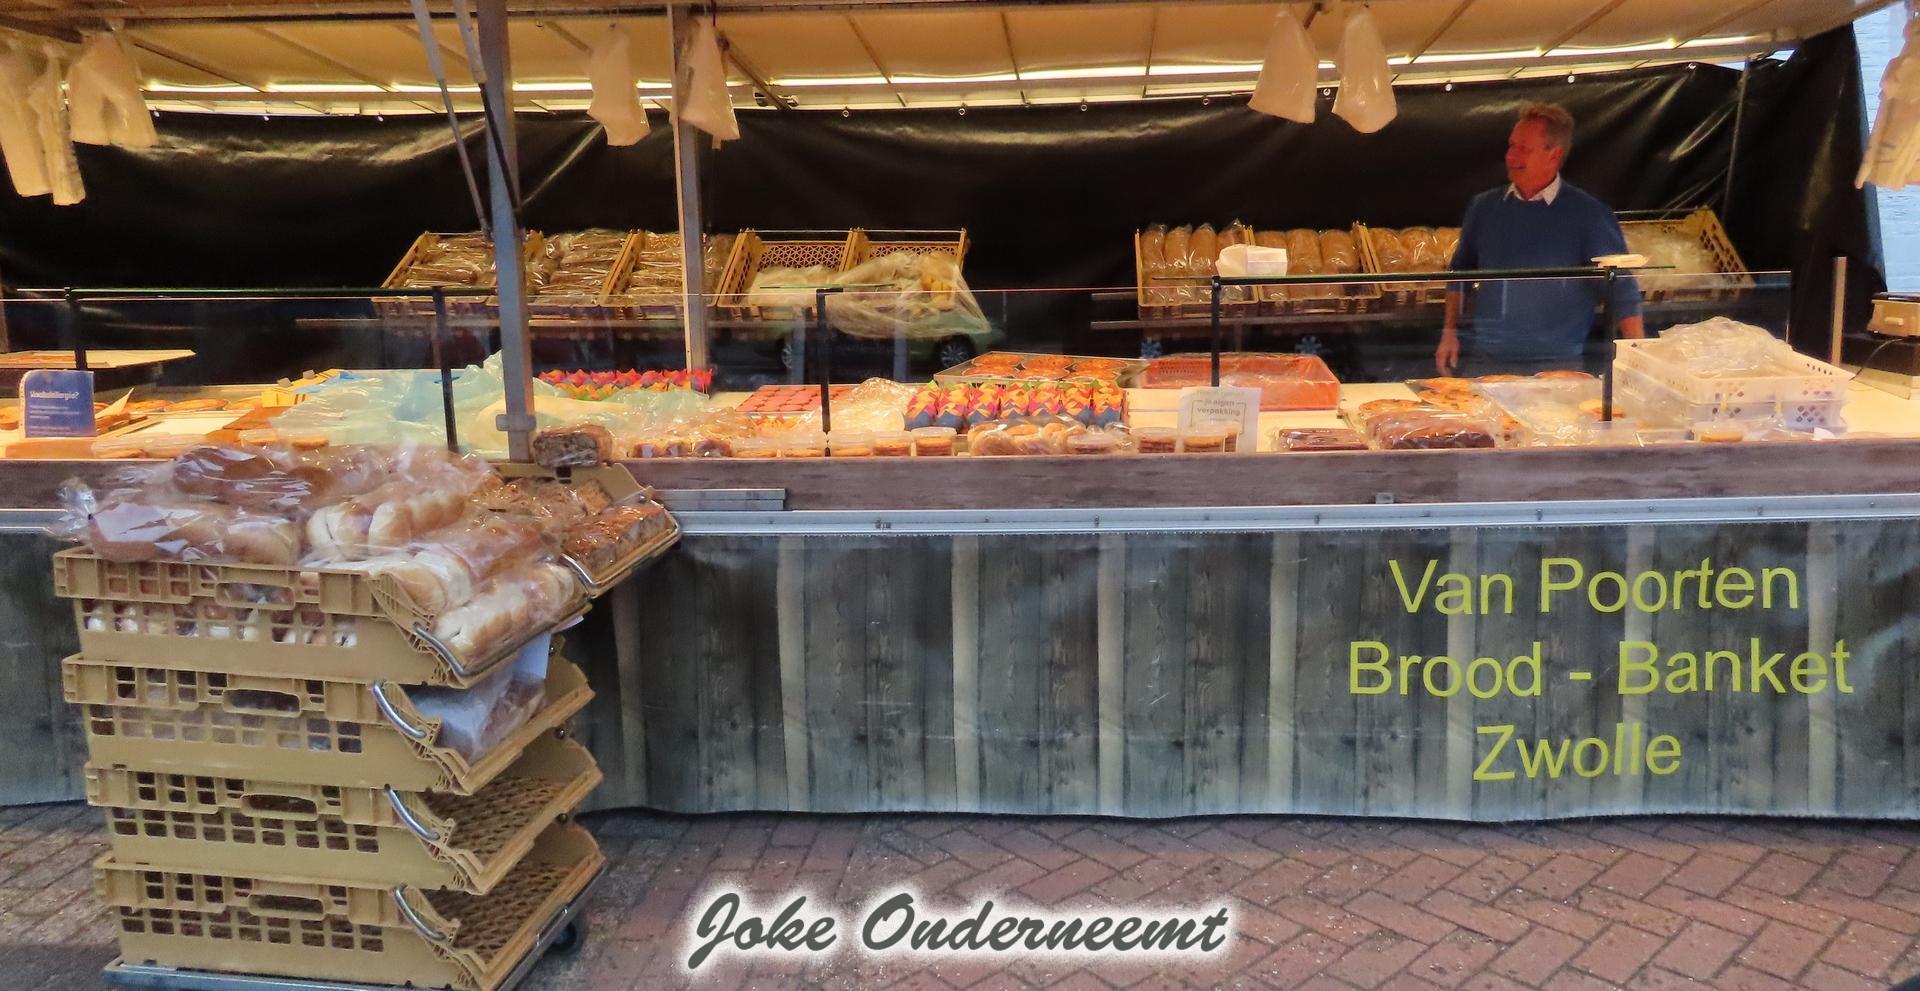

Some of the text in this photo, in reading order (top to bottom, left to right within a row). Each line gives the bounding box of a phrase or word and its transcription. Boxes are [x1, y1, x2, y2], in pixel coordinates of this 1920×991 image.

[1197, 408, 1241, 416] verpakking
[1389, 557, 1799, 614] Van Poorten
[1350, 637, 1854, 698] Brood - Banket
[1473, 722, 1682, 781] Zwolle
